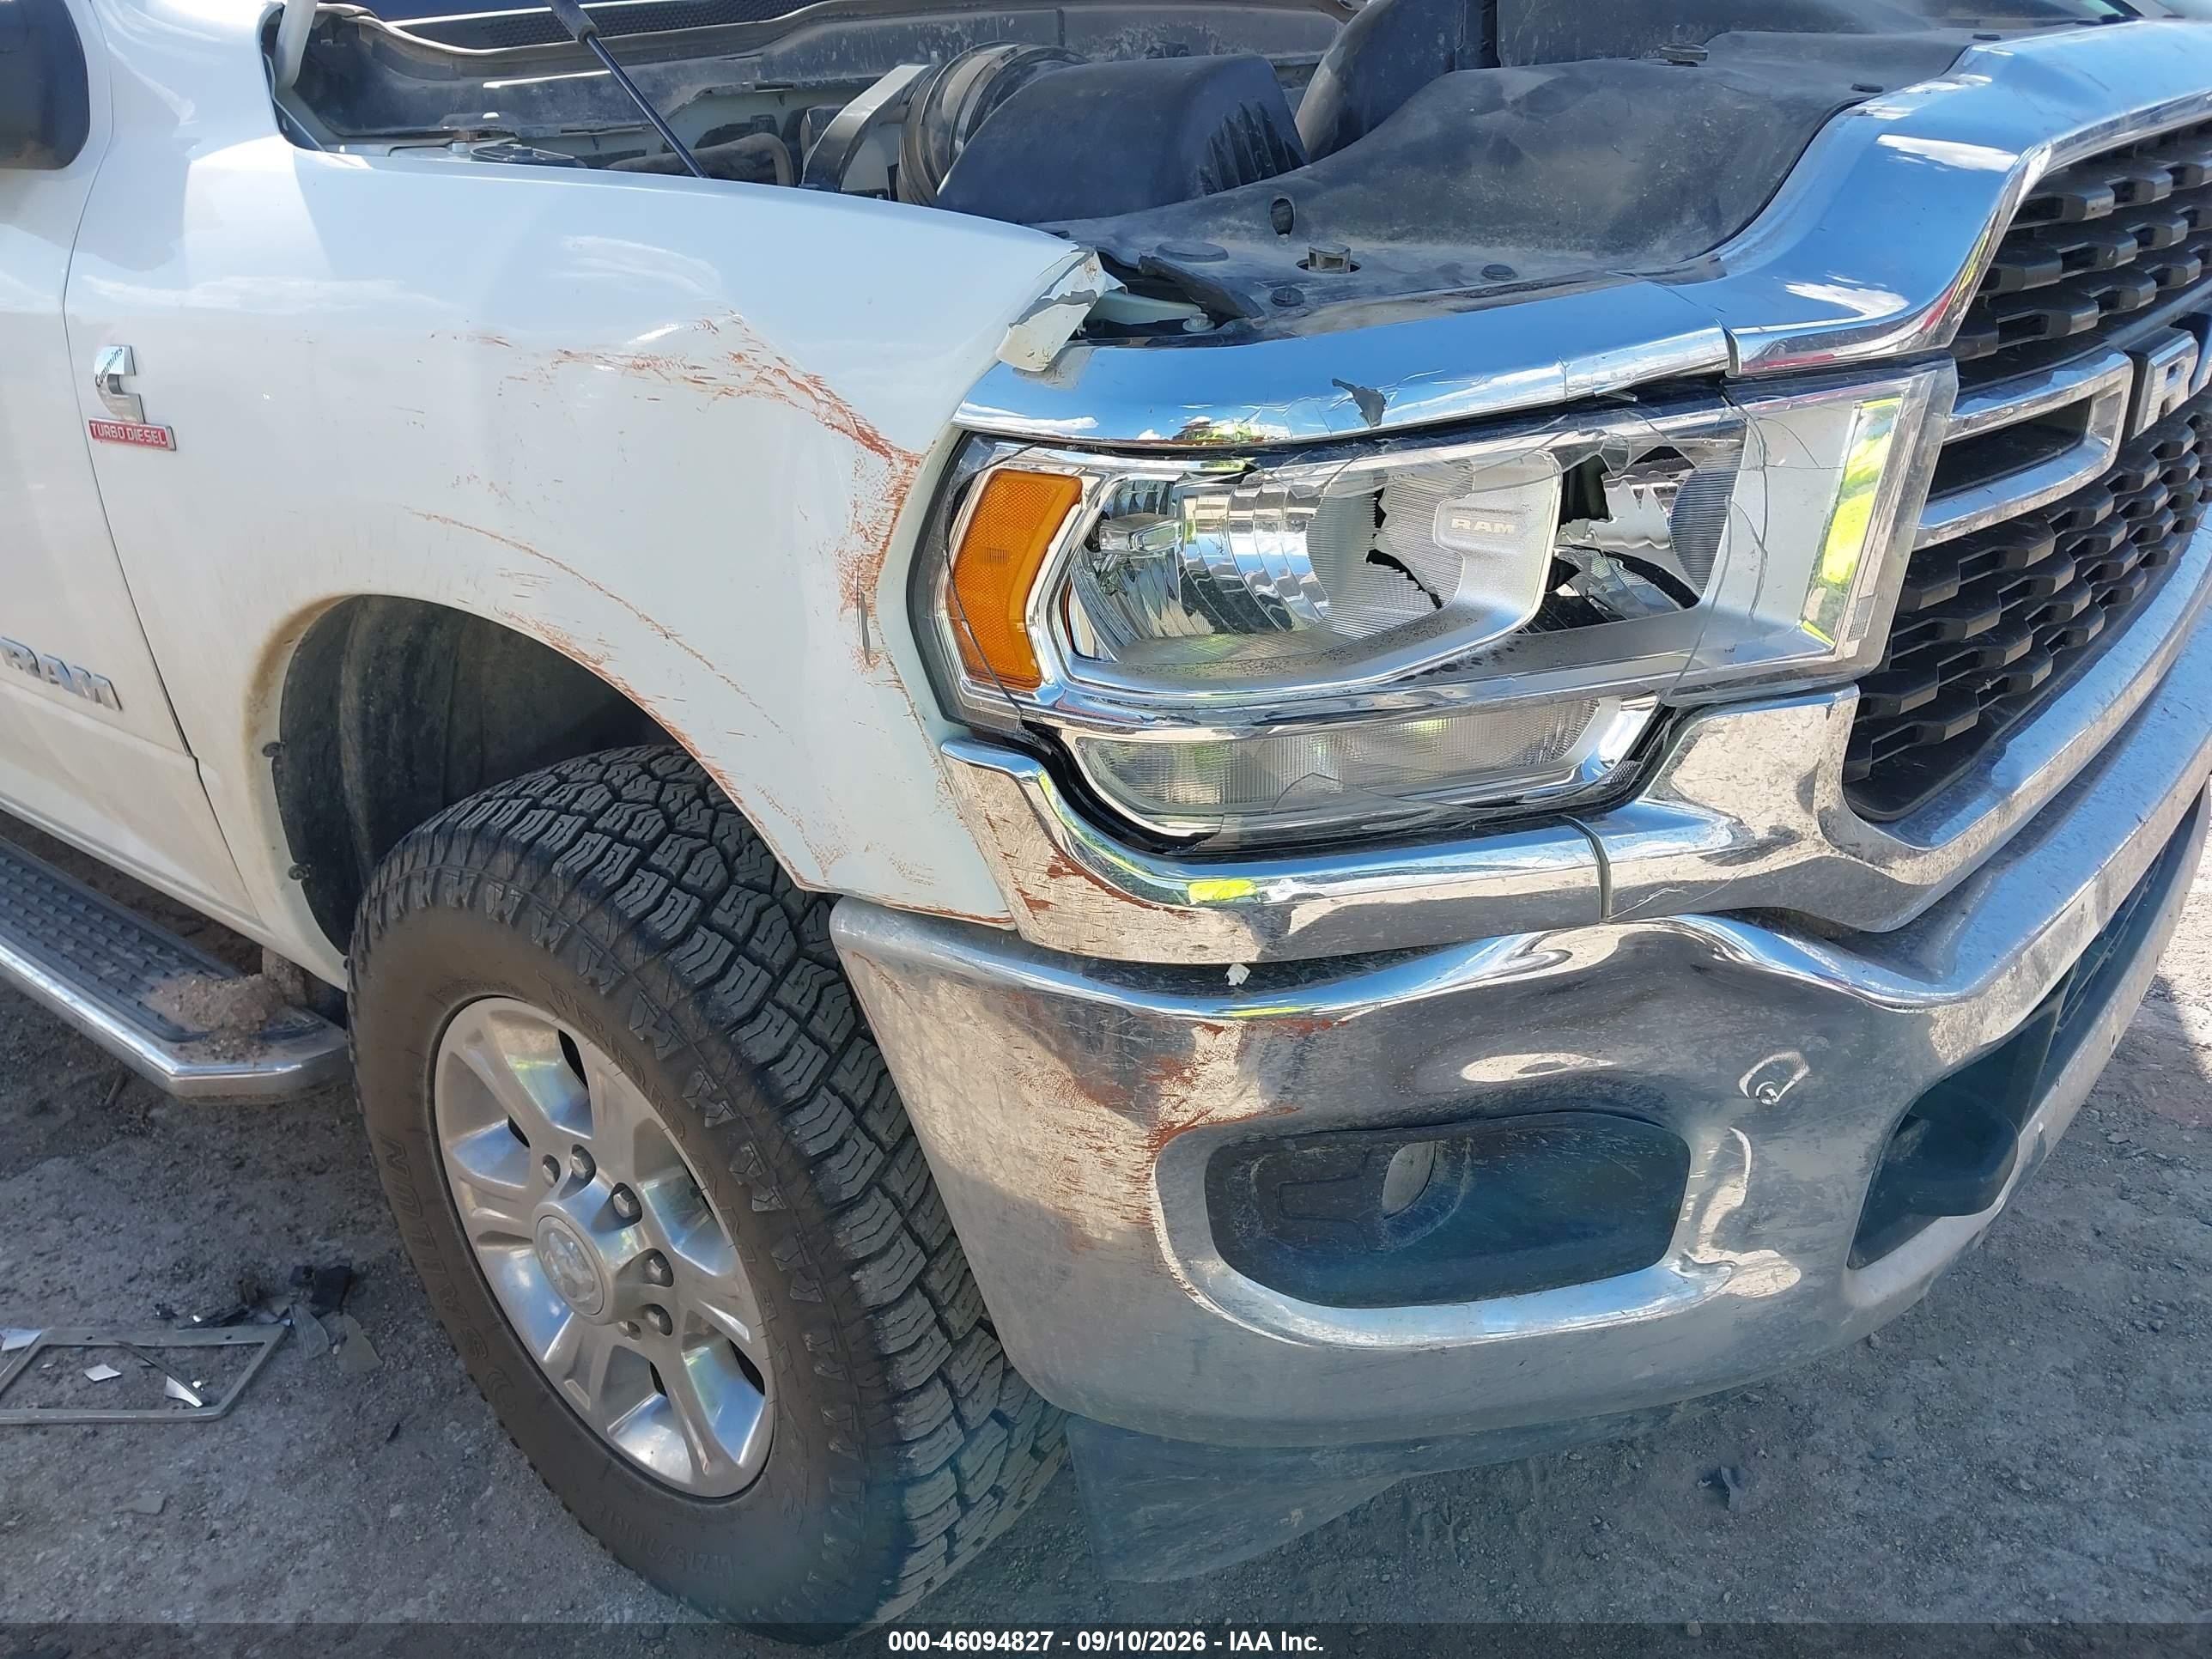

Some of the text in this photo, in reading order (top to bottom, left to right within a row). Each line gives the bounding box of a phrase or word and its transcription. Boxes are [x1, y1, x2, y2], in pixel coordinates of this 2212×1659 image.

[94, 347, 123, 388] Cummins
[90, 422, 167, 445] TURBO DIESEL
[1451, 518, 1516, 534] RAM
